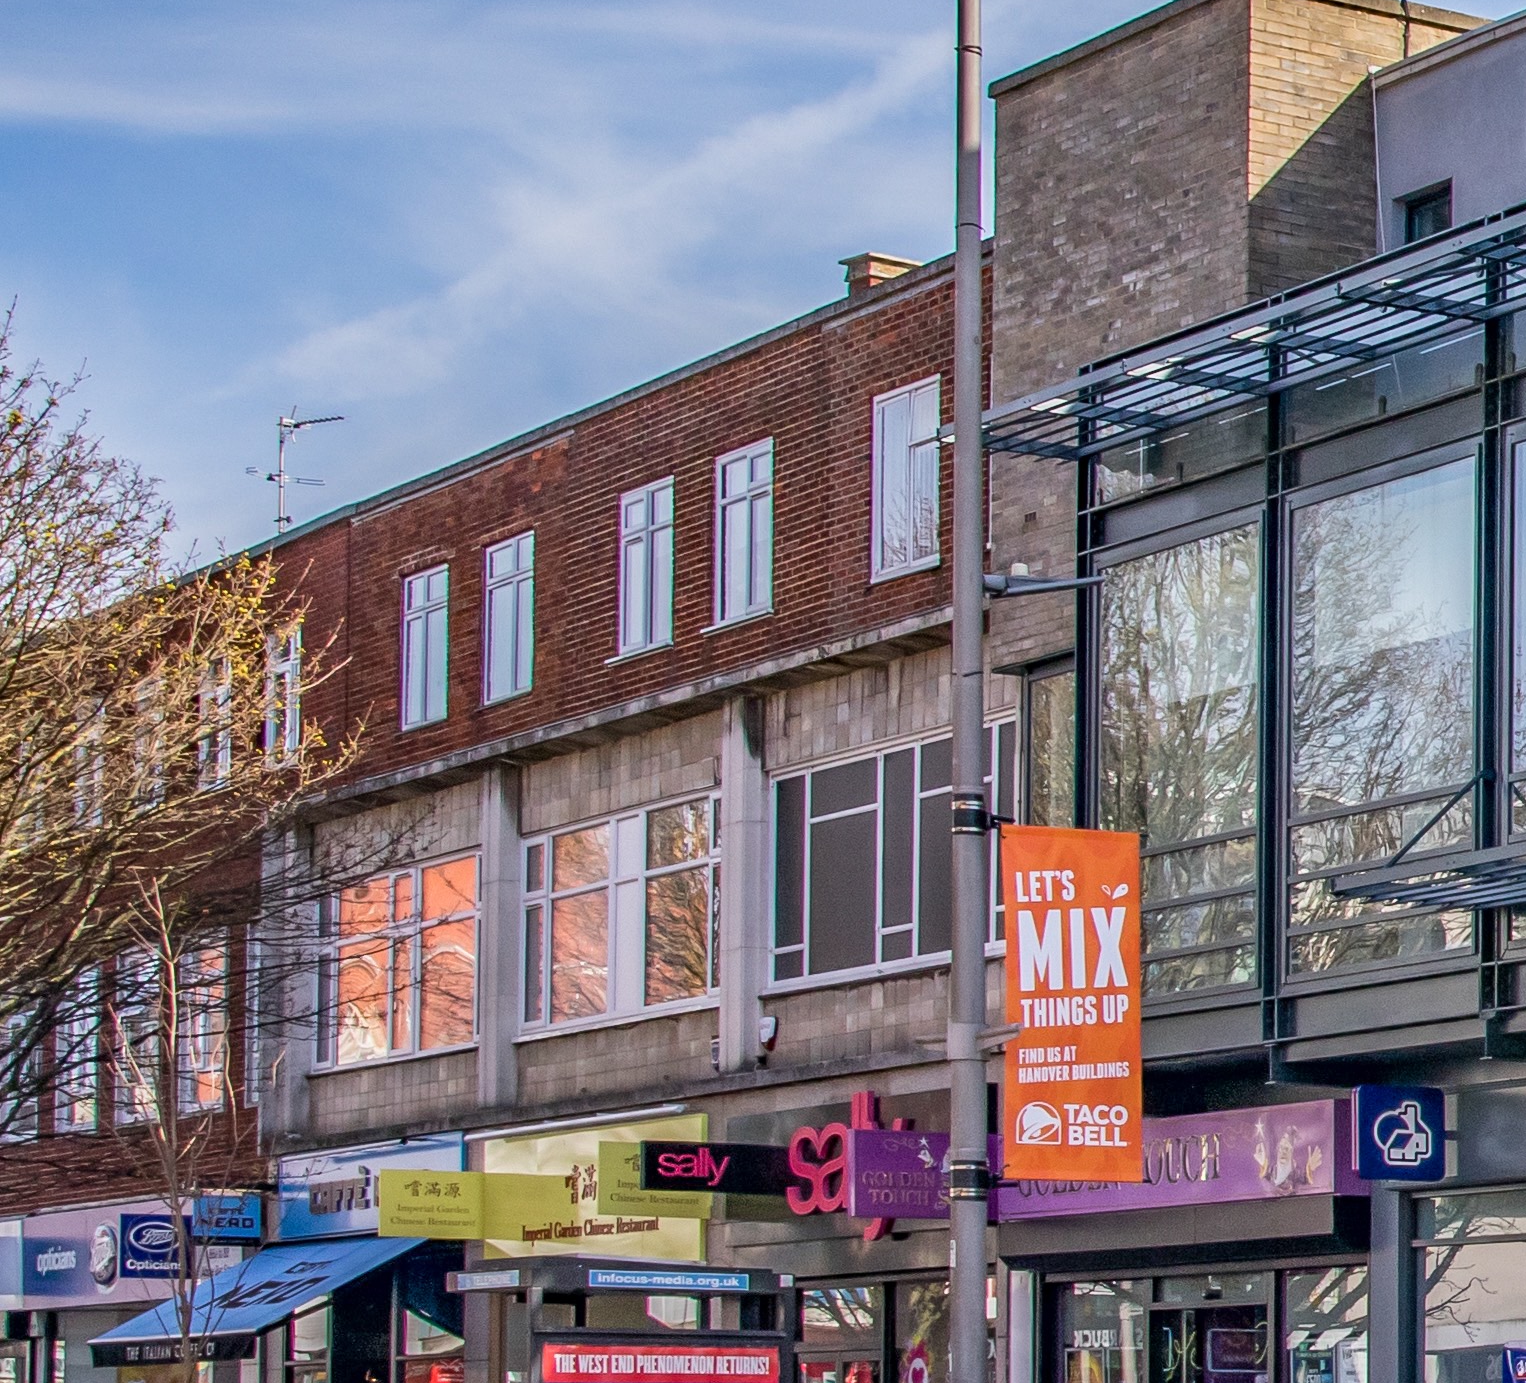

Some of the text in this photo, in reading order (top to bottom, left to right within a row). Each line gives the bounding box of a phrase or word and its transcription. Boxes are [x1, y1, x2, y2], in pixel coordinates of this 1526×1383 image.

[1016, 870, 1075, 902] LET'S
[1018, 907, 1129, 991] MIX
[1020, 994, 1129, 1028] THINGS UP
[1018, 1046, 1077, 1064] FIND US AT
[1018, 1062, 1130, 1083] HANOVER BUILDINGS
[1063, 1104, 1128, 1126] TACO
[1068, 1125, 1128, 1147] BELL
[657, 1147, 731, 1186] sally
[610, 1193, 700, 1206] Chinese Restaurant
[868, 1189, 929, 1205] TOUCH
[398, 1204, 469, 1215] Imperial Garden
[390, 1217, 426, 1225] Chinese
[522, 1216, 659, 1249] Imperial Garden Chinese Restaurant
[37, 1247, 76, 1276] opticians
[598, 1273, 740, 1288] infocus-media.org.uk
[126, 1347, 139, 1361] THE
[143, 1345, 171, 1360] ITALIAN
[554, 1354, 770, 1375] THE WEST END PHENOMENON RETURNS!
